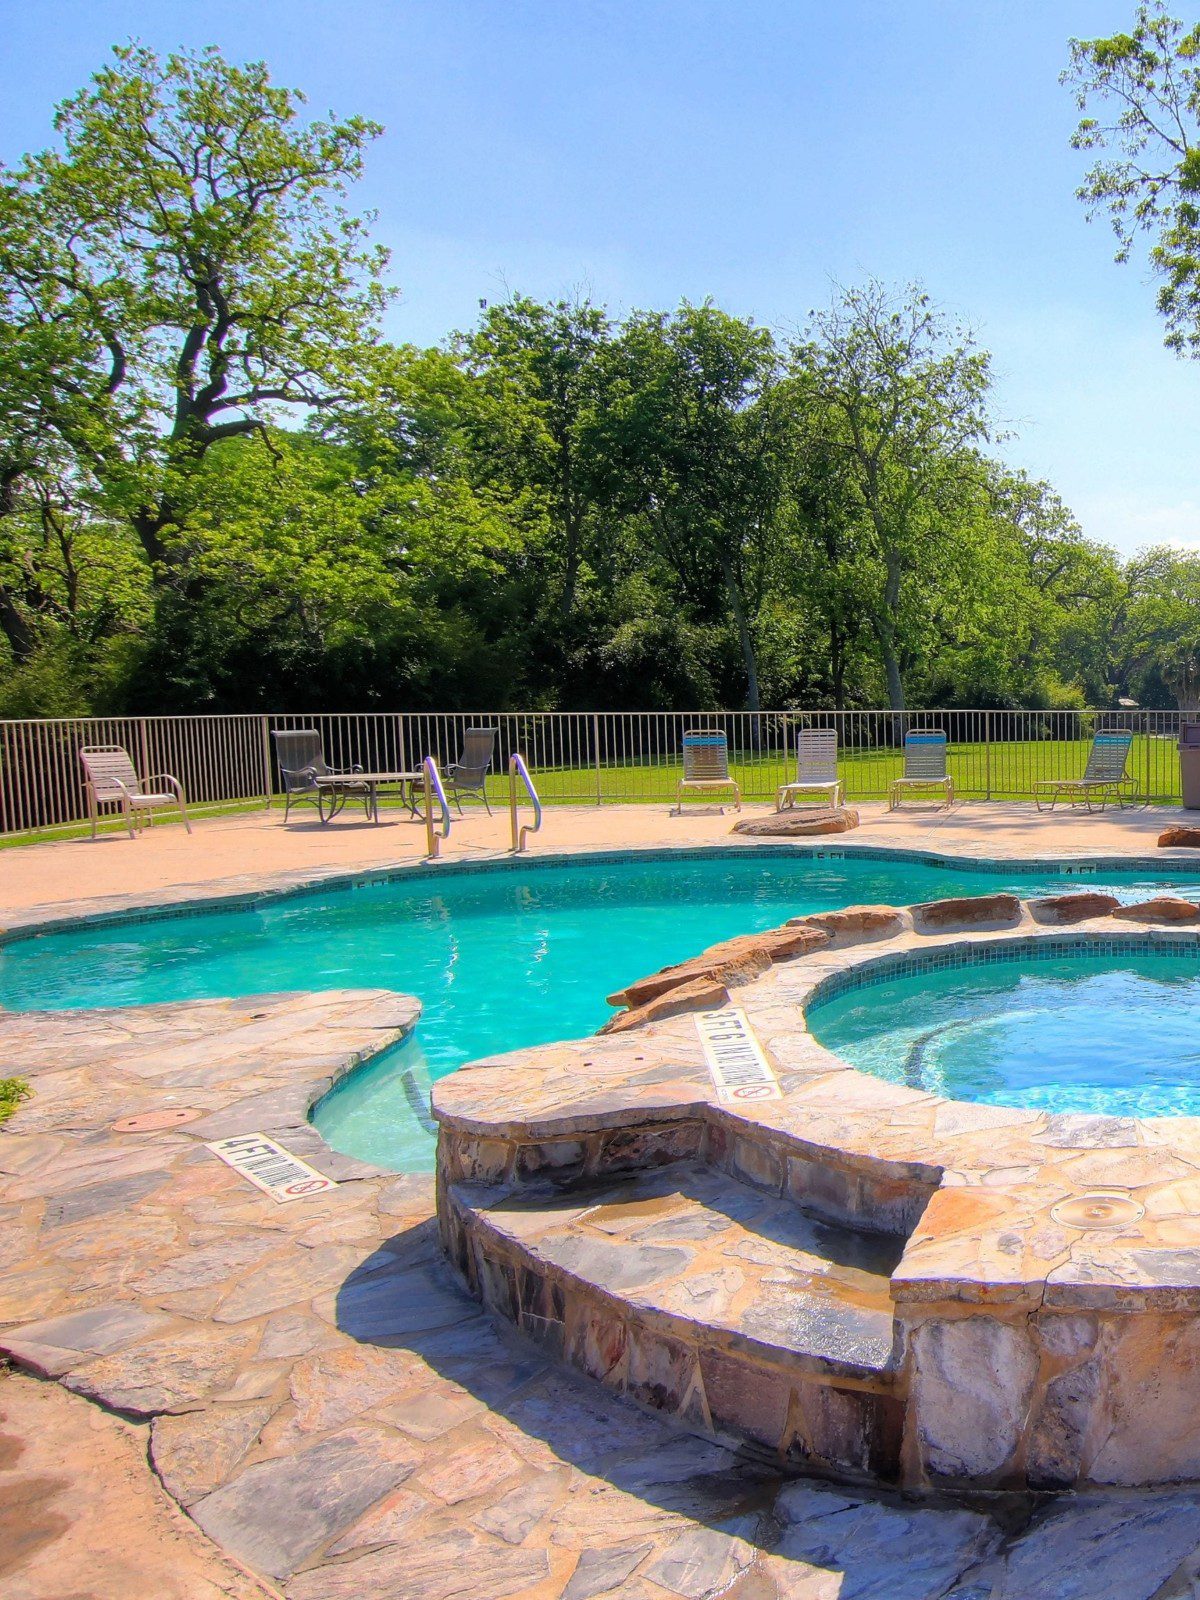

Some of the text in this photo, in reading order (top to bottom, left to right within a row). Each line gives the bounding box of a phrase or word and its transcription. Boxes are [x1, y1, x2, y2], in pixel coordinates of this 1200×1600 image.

[703, 1020, 742, 1031] FT
[711, 1042, 753, 1055] IN
[219, 1139, 260, 1150] 4
[227, 1144, 278, 1161] FT
